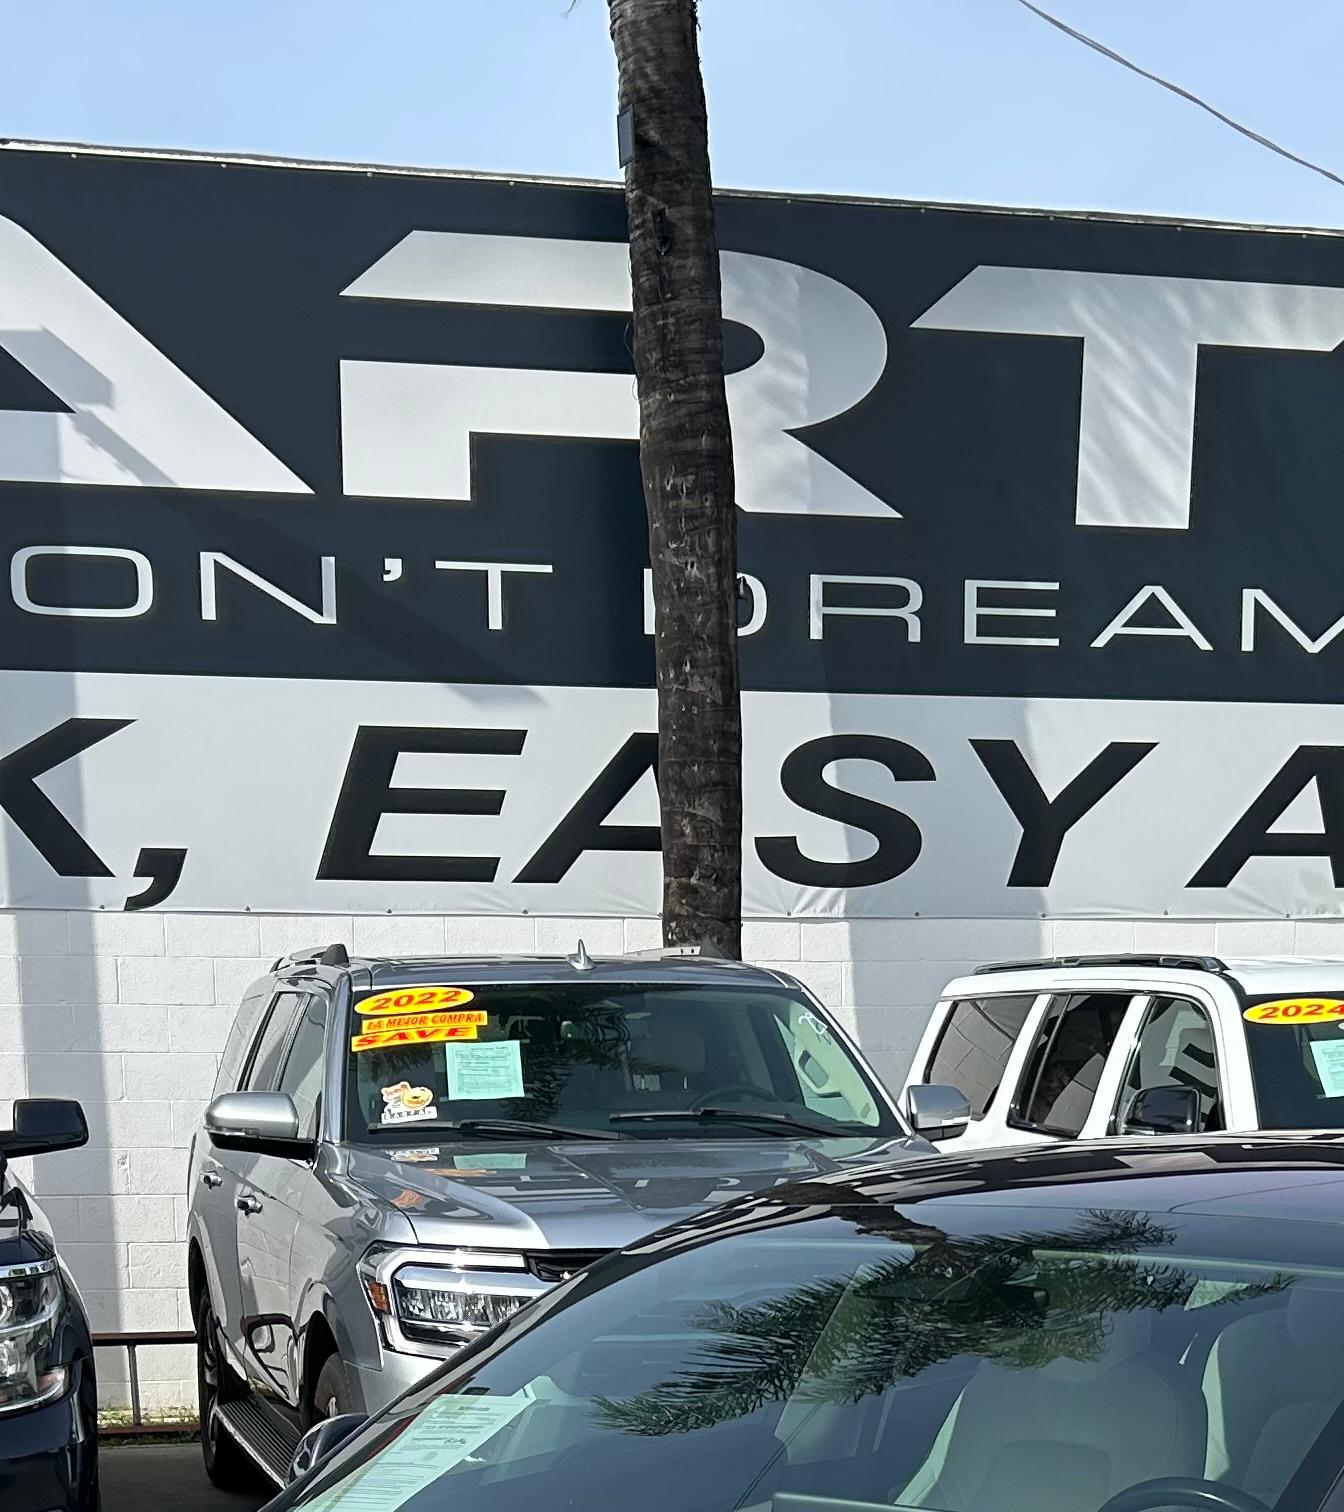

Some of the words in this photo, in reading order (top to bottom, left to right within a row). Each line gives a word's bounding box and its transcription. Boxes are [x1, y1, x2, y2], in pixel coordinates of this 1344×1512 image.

[370, 990, 463, 1012] 2022
[386, 1015, 427, 1028] MEJOR
[432, 1013, 483, 1025] COMPRA
[354, 1026, 472, 1047] SAVE
